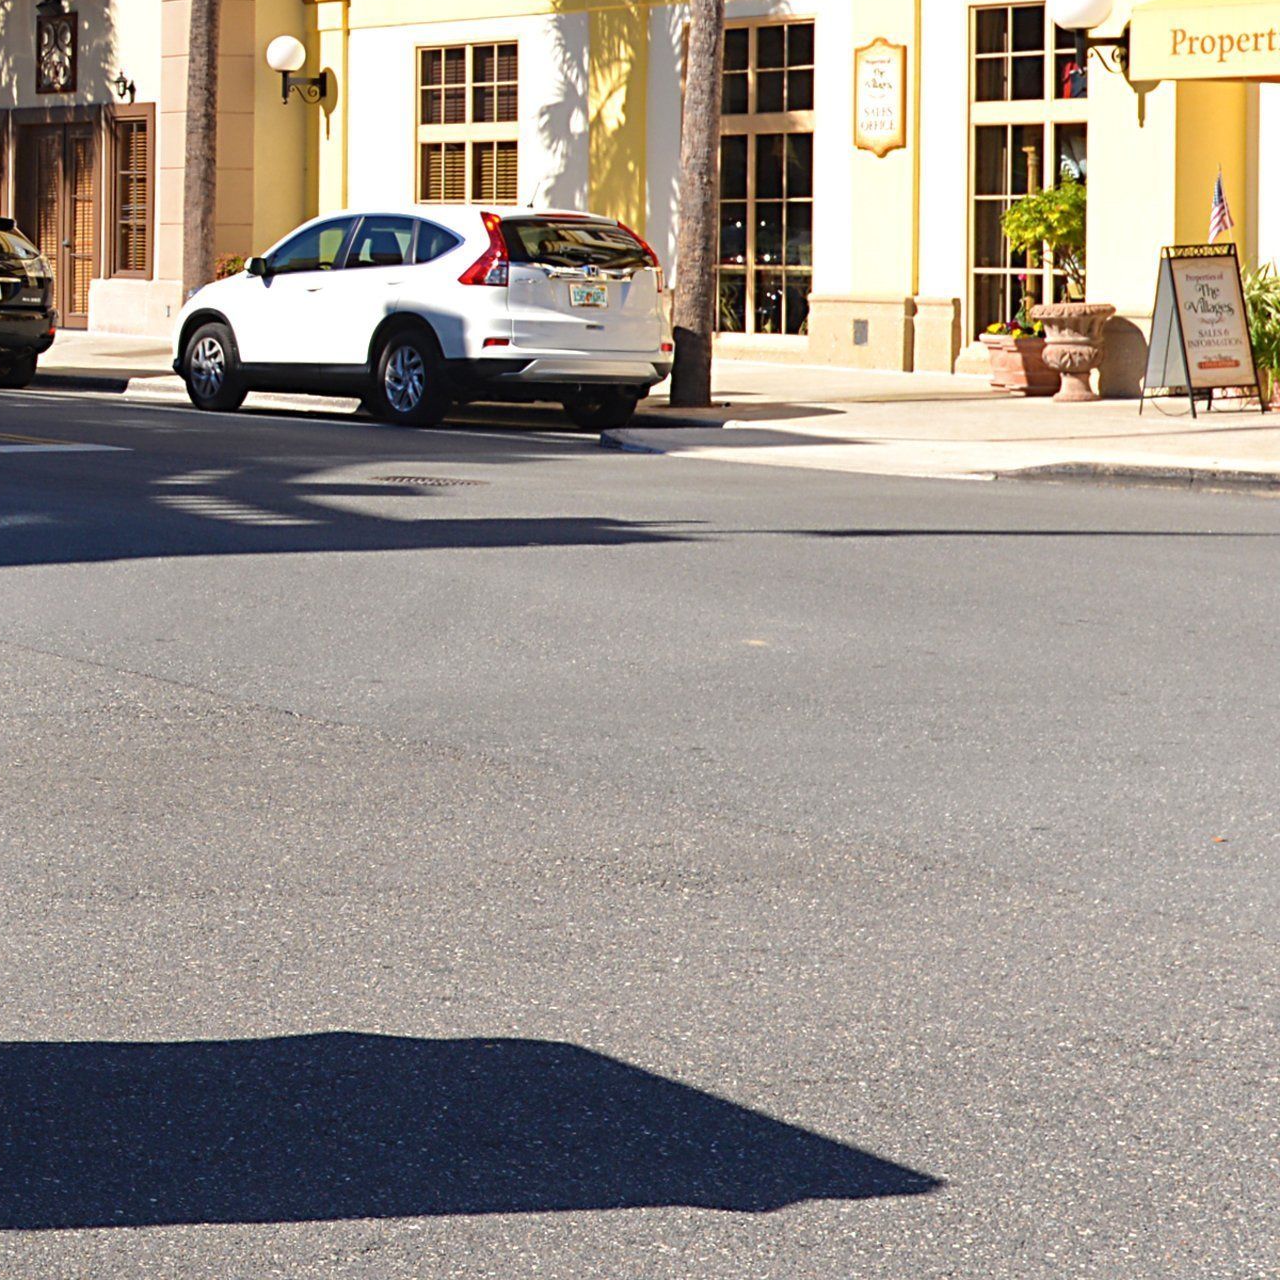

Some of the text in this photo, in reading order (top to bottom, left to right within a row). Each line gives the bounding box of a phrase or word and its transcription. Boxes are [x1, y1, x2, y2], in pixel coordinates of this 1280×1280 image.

[1170, 28, 1280, 63] Propert
[1185, 271, 1224, 282] Properties of
[1195, 283, 1220, 299] The
[1184, 297, 1236, 318] Villages
[1198, 329, 1223, 338] SALES
[1187, 337, 1243, 349] INFORMATION
